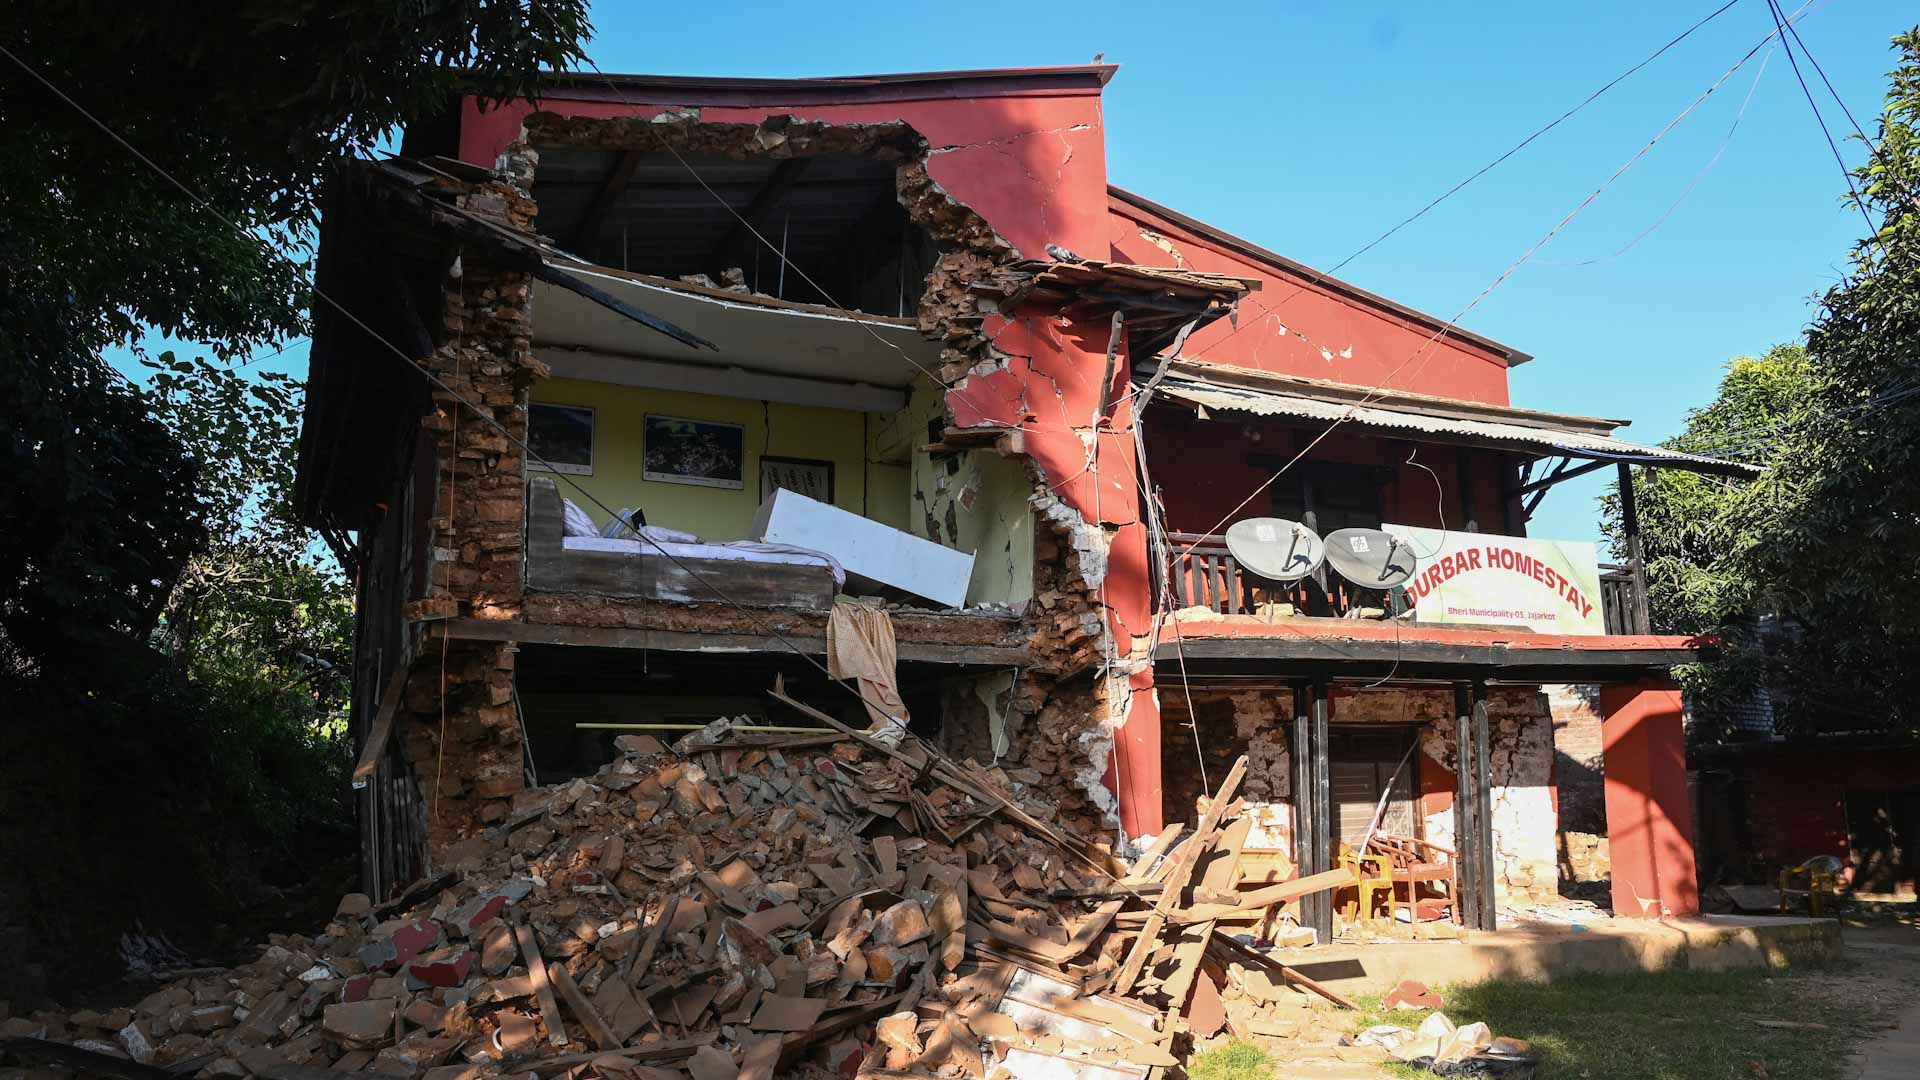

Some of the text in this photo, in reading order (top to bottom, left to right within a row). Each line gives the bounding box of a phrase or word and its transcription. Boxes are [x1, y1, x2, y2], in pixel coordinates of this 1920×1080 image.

[1404, 546, 1592, 618] DURBAR HOMESTAY
[1448, 607, 1468, 615] Bheri
[1528, 611, 1556, 621] Jajarkot
